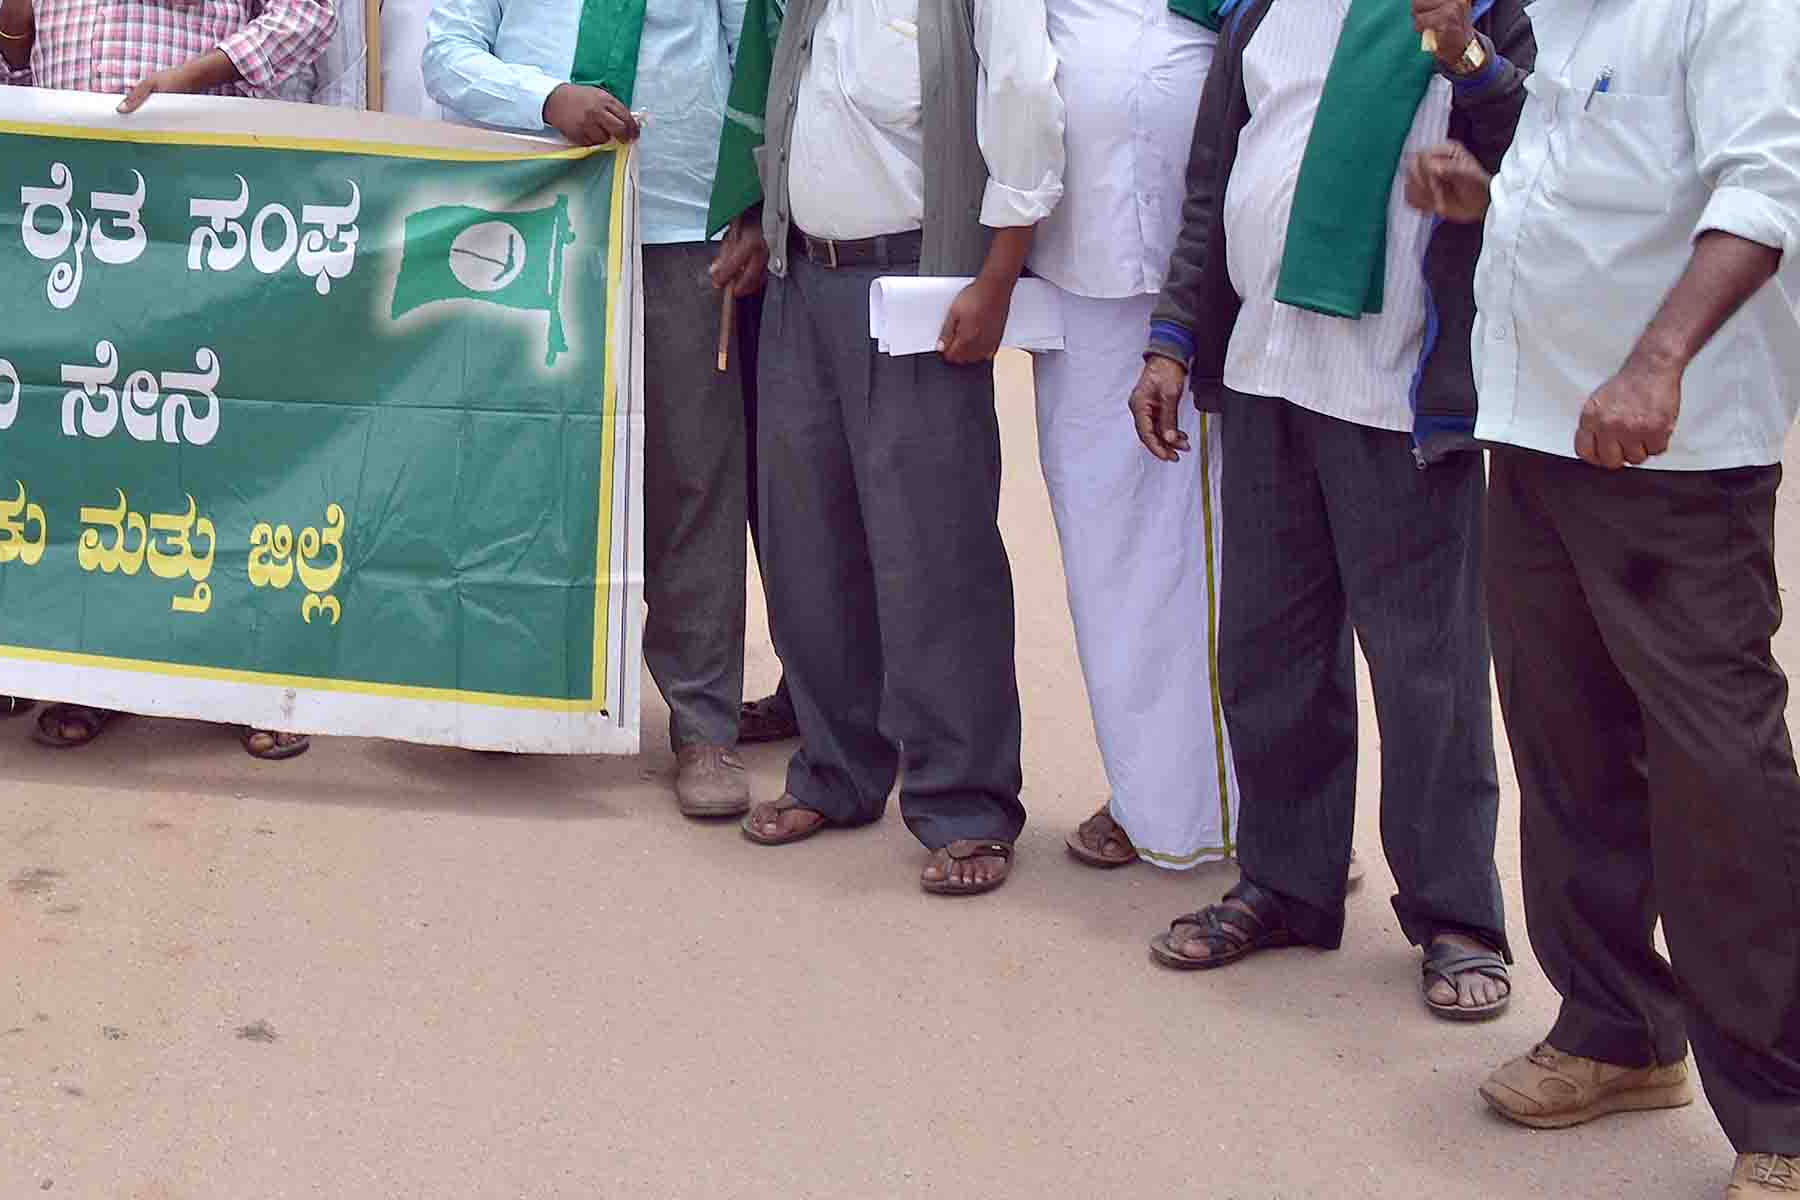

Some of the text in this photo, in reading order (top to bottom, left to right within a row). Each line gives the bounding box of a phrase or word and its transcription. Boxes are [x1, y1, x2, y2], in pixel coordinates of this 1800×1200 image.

[21, 161, 147, 309] ರೈತ
[186, 173, 361, 295] ಸಂಘ
[60, 339, 220, 446] ಸೇನೆ
[77, 488, 217, 613] ಮತ್ತು
[247, 503, 345, 624] ಜಿಲ್ಲೆ
